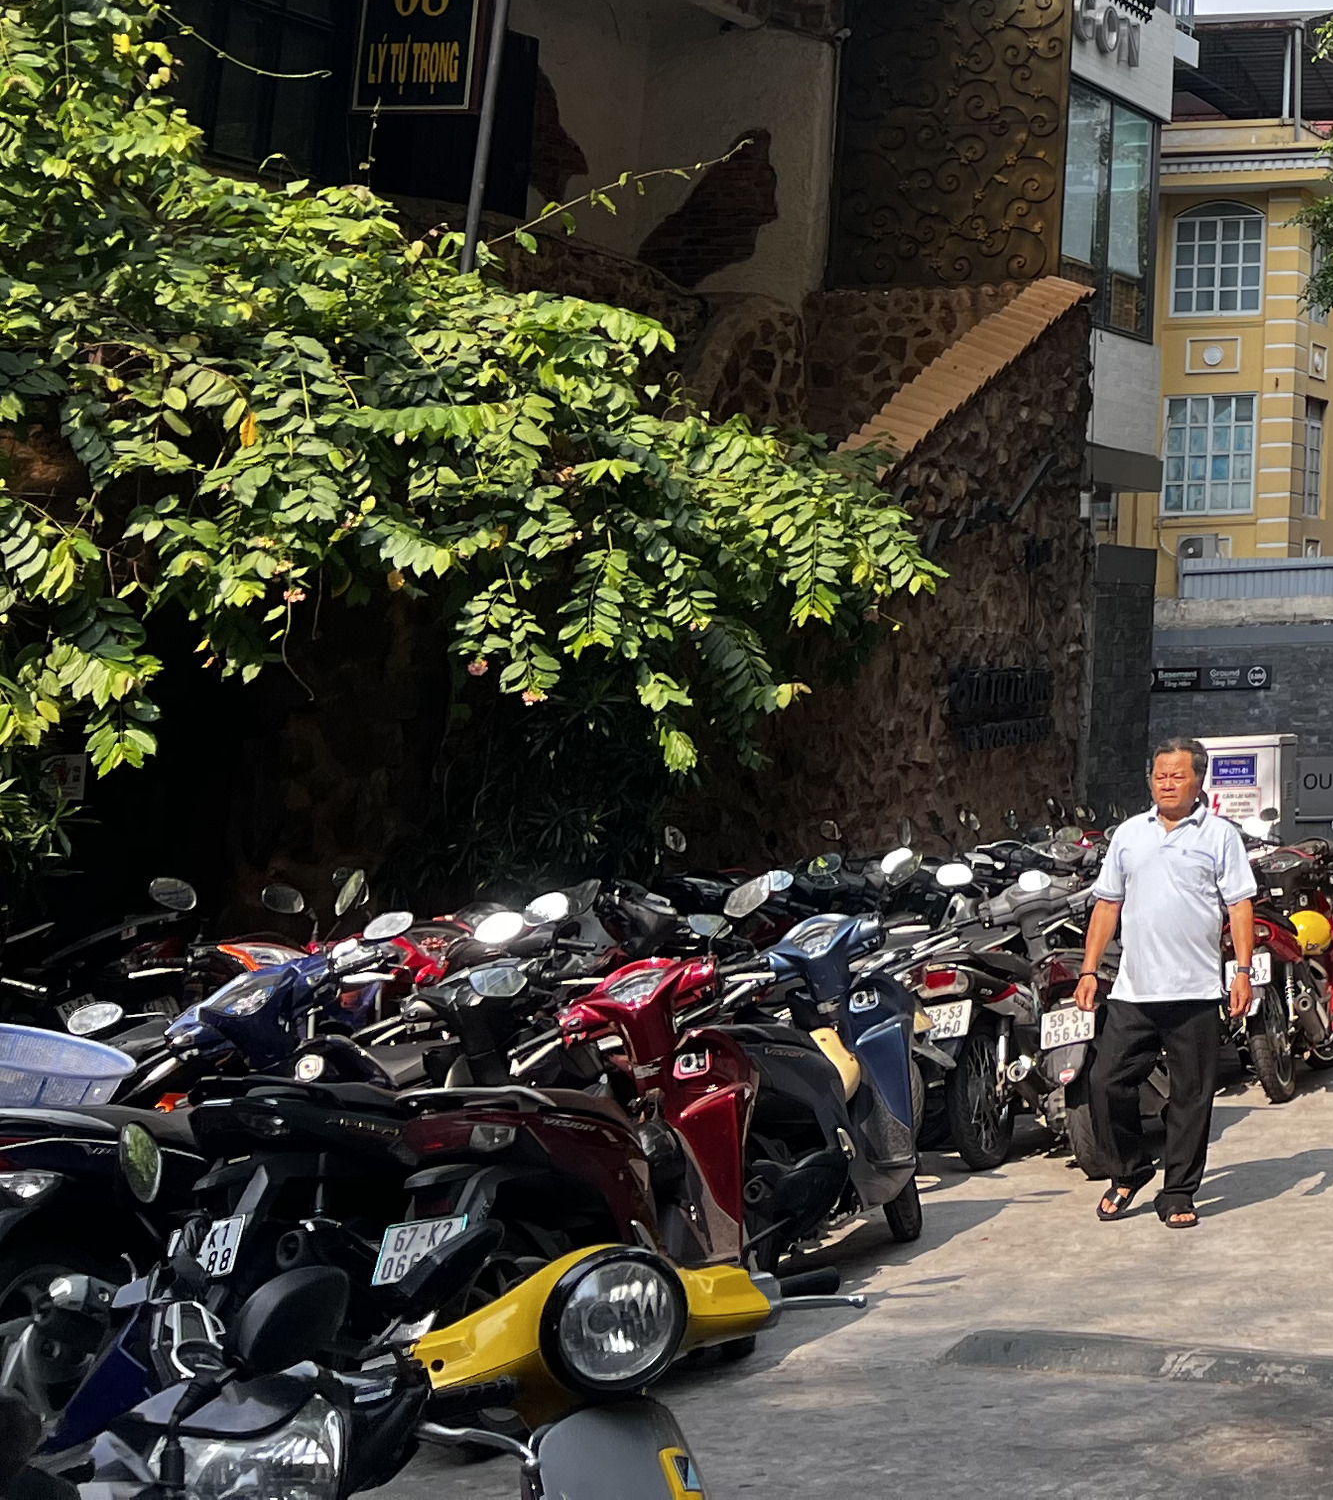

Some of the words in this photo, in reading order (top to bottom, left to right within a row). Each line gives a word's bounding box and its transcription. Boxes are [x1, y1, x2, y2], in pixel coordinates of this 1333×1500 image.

[367, 33, 388, 84] LÝ
[412, 41, 460, 95] TRỌNG
[1158, 670, 1198, 679] Basement
[1209, 668, 1240, 678] Ground
[1045, 1022, 1091, 1047] 056.43
[543, 1116, 598, 1132] VISION
[394, 1221, 453, 1253] 67-K2
